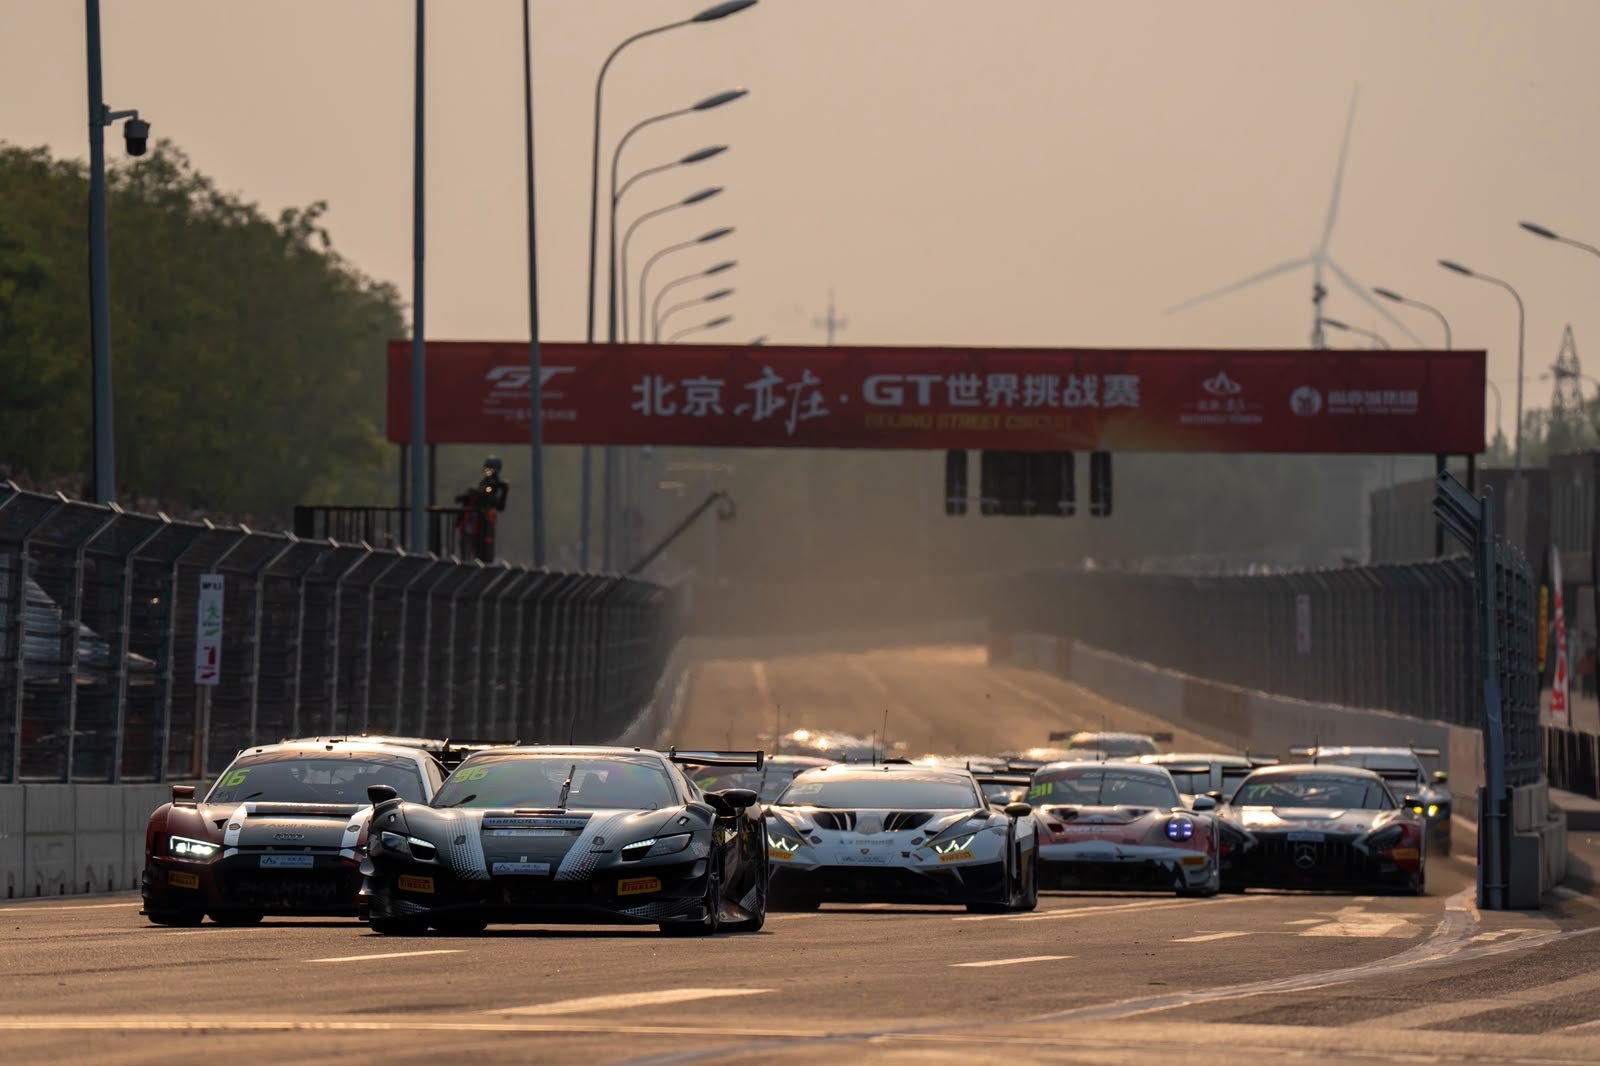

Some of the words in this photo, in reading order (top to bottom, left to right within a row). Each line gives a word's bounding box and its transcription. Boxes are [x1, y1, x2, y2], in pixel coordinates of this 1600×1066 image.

[218, 767, 252, 788] 16
[1247, 784, 1273, 799] 77
[488, 818, 538, 826] HARMONY
[621, 879, 659, 892] PIRELLI
